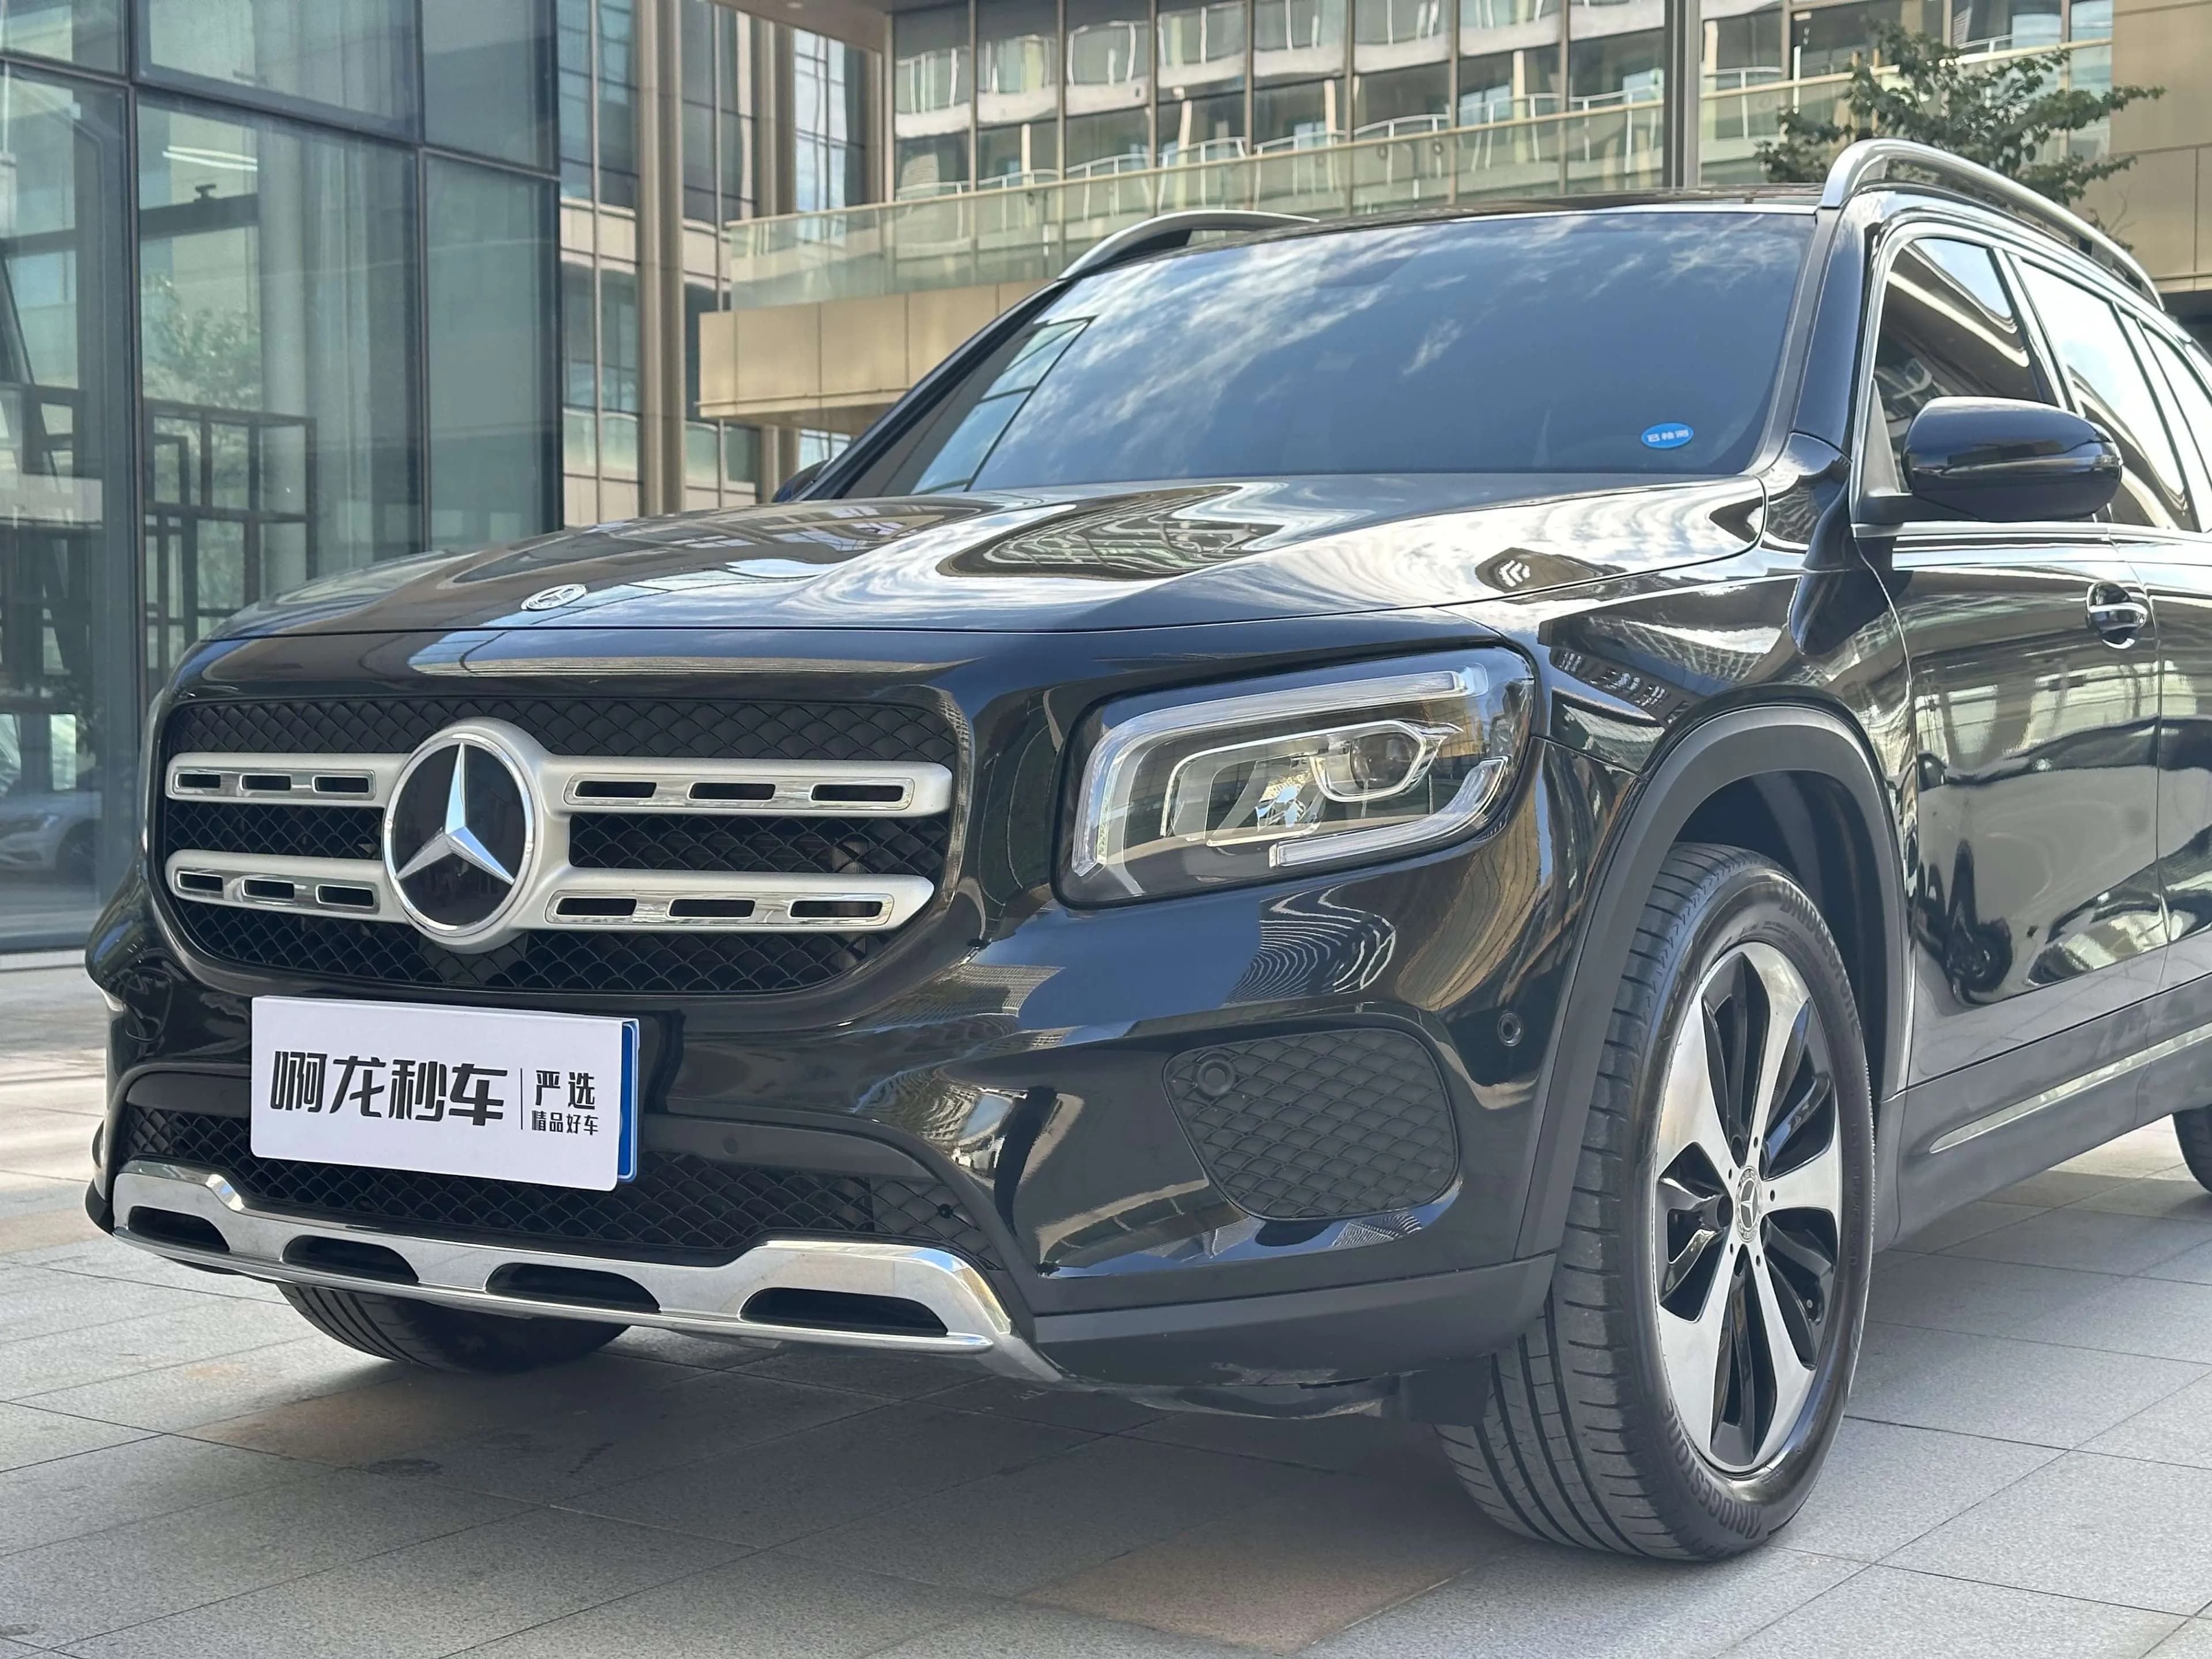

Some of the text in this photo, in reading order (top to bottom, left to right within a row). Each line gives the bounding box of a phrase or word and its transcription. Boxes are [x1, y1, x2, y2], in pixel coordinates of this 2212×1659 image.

[270, 1051, 508, 1126] 啊龙秒车
[535, 1070, 596, 1110] 严选
[531, 1109, 599, 1135] 精品好车
[1660, 1397, 1761, 1540] BRIDGESTONE
